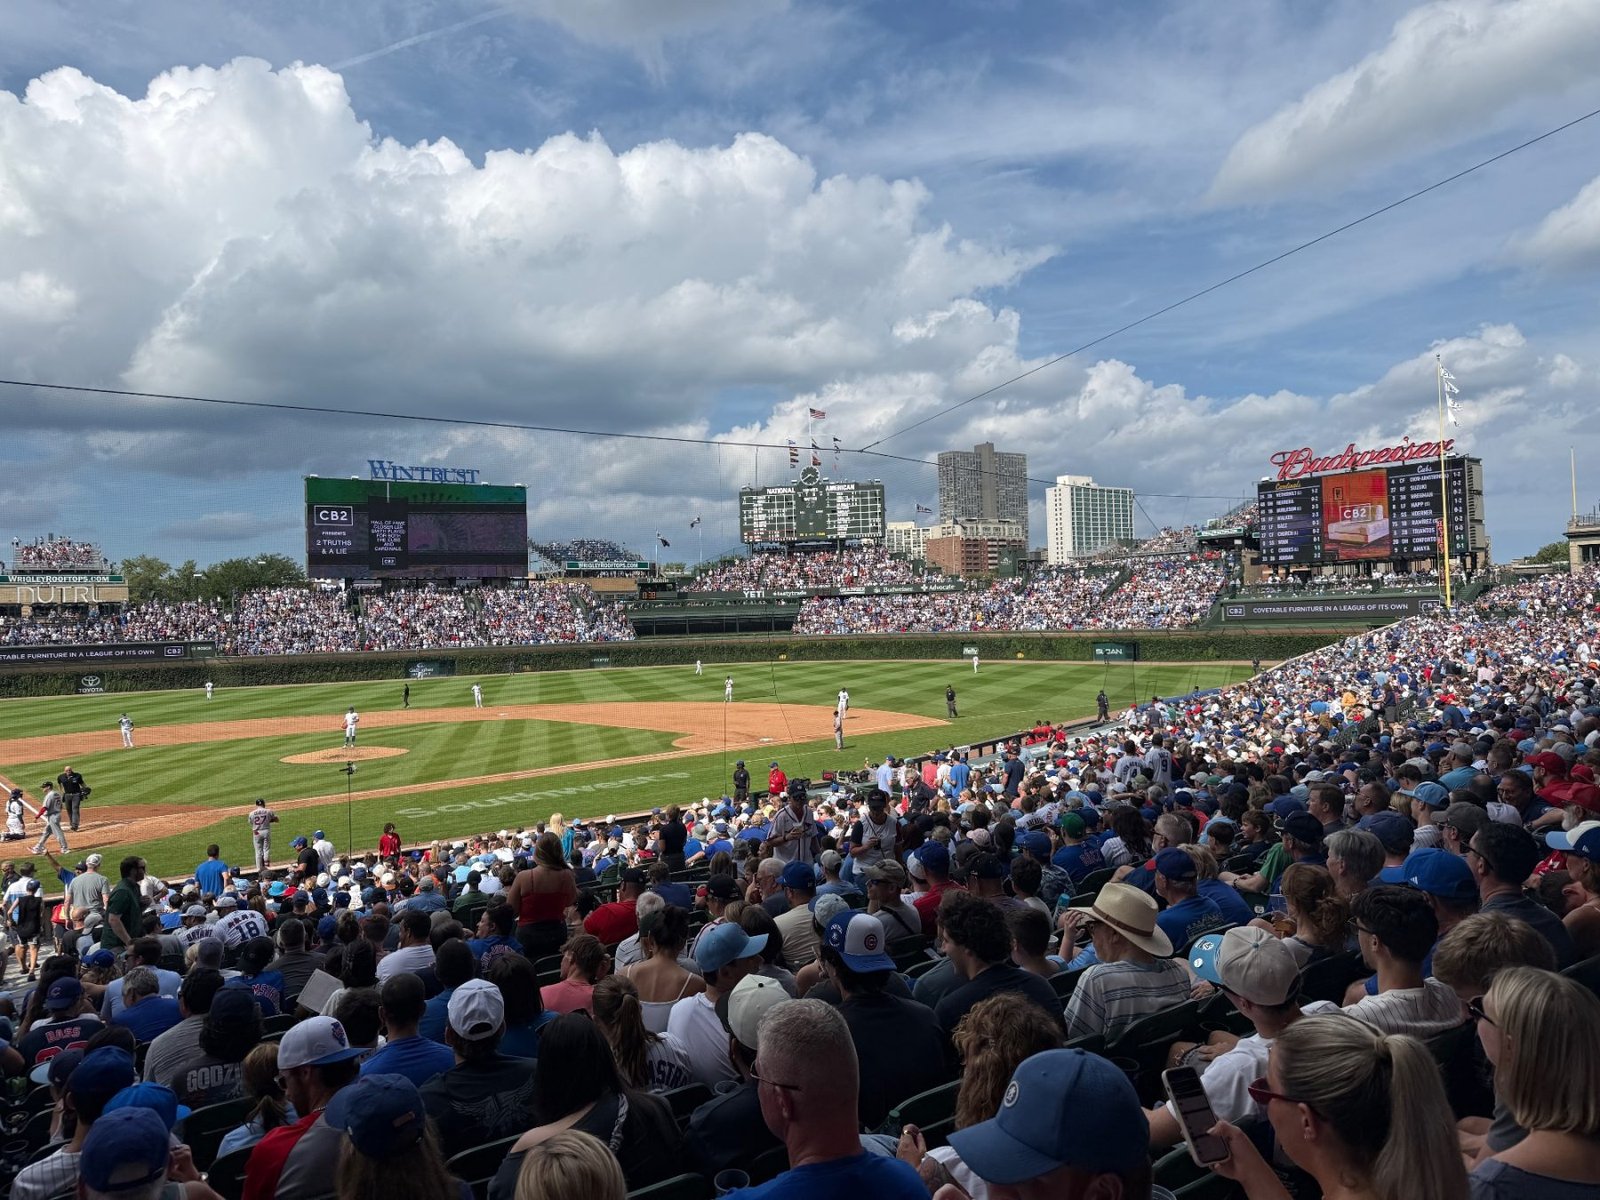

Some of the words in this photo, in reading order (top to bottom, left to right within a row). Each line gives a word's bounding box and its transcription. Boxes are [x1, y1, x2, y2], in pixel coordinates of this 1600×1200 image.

[1270, 436, 1455, 480] Budweiser
[367, 459, 480, 484] WINTRUST
[1417, 464, 1432, 473] Cubs
[320, 510, 348, 521] CB2
[1344, 508, 1367, 518] CB2
[1161, 759, 1167, 772] 9
[254, 815, 266, 825] 27
[186, 928, 213, 942] BRYANT
[236, 920, 260, 941] 18
